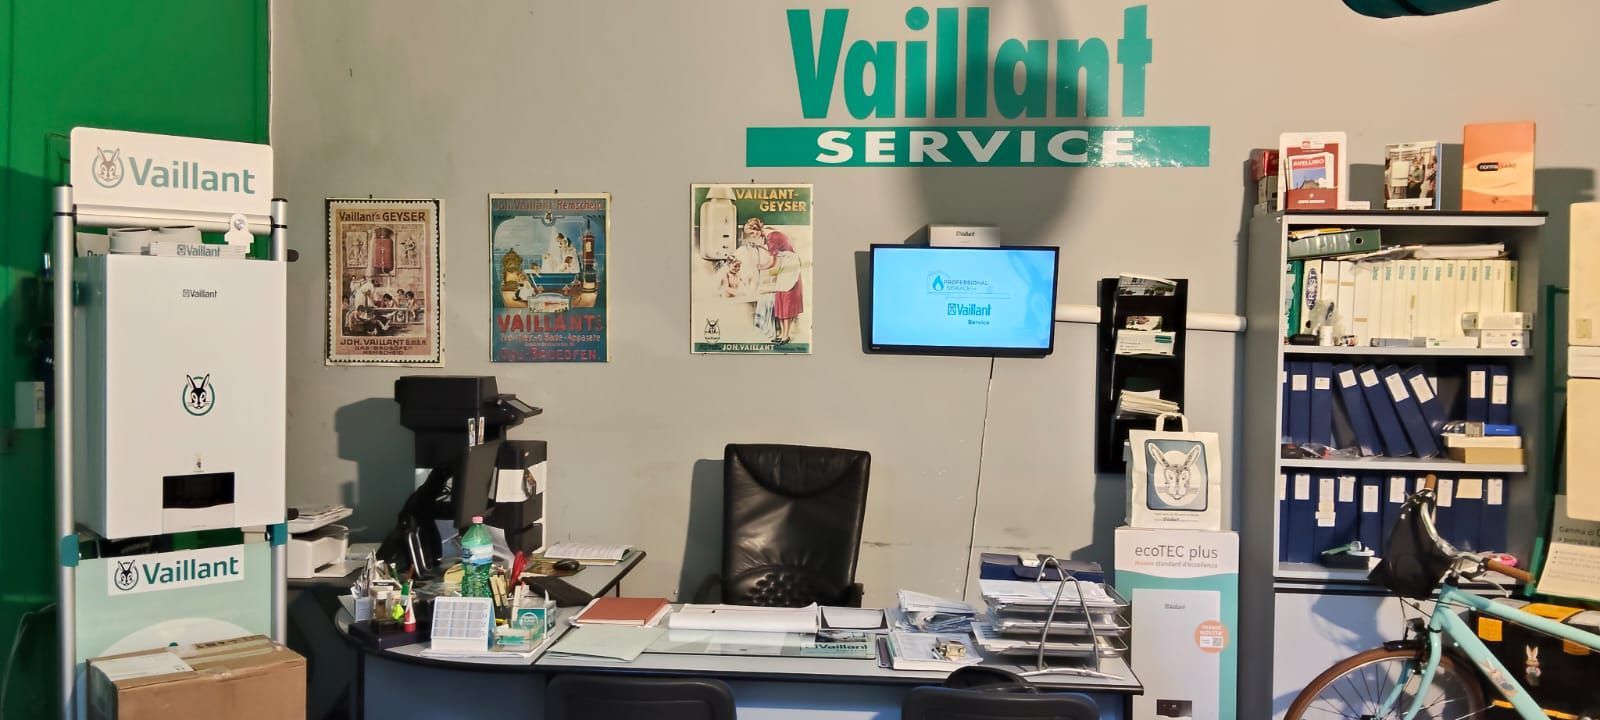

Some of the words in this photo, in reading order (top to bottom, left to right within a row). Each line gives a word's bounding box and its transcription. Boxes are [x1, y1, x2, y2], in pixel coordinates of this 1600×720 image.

[786, 4, 1153, 120] Vaillant
[815, 130, 1135, 164] SERVICE
[1293, 158, 1325, 167] AVELLINO
[128, 156, 255, 194] Vaillant
[760, 201, 808, 212] GEYSER
[382, 211, 426, 222] GEYSER
[186, 244, 221, 257] Vaillant
[190, 289, 218, 299] Vaillant
[956, 303, 992, 316] Vaillant
[1135, 544, 1185, 558] ecoTEC
[1189, 544, 1219, 561] plus
[142, 556, 240, 585] Vaillant
